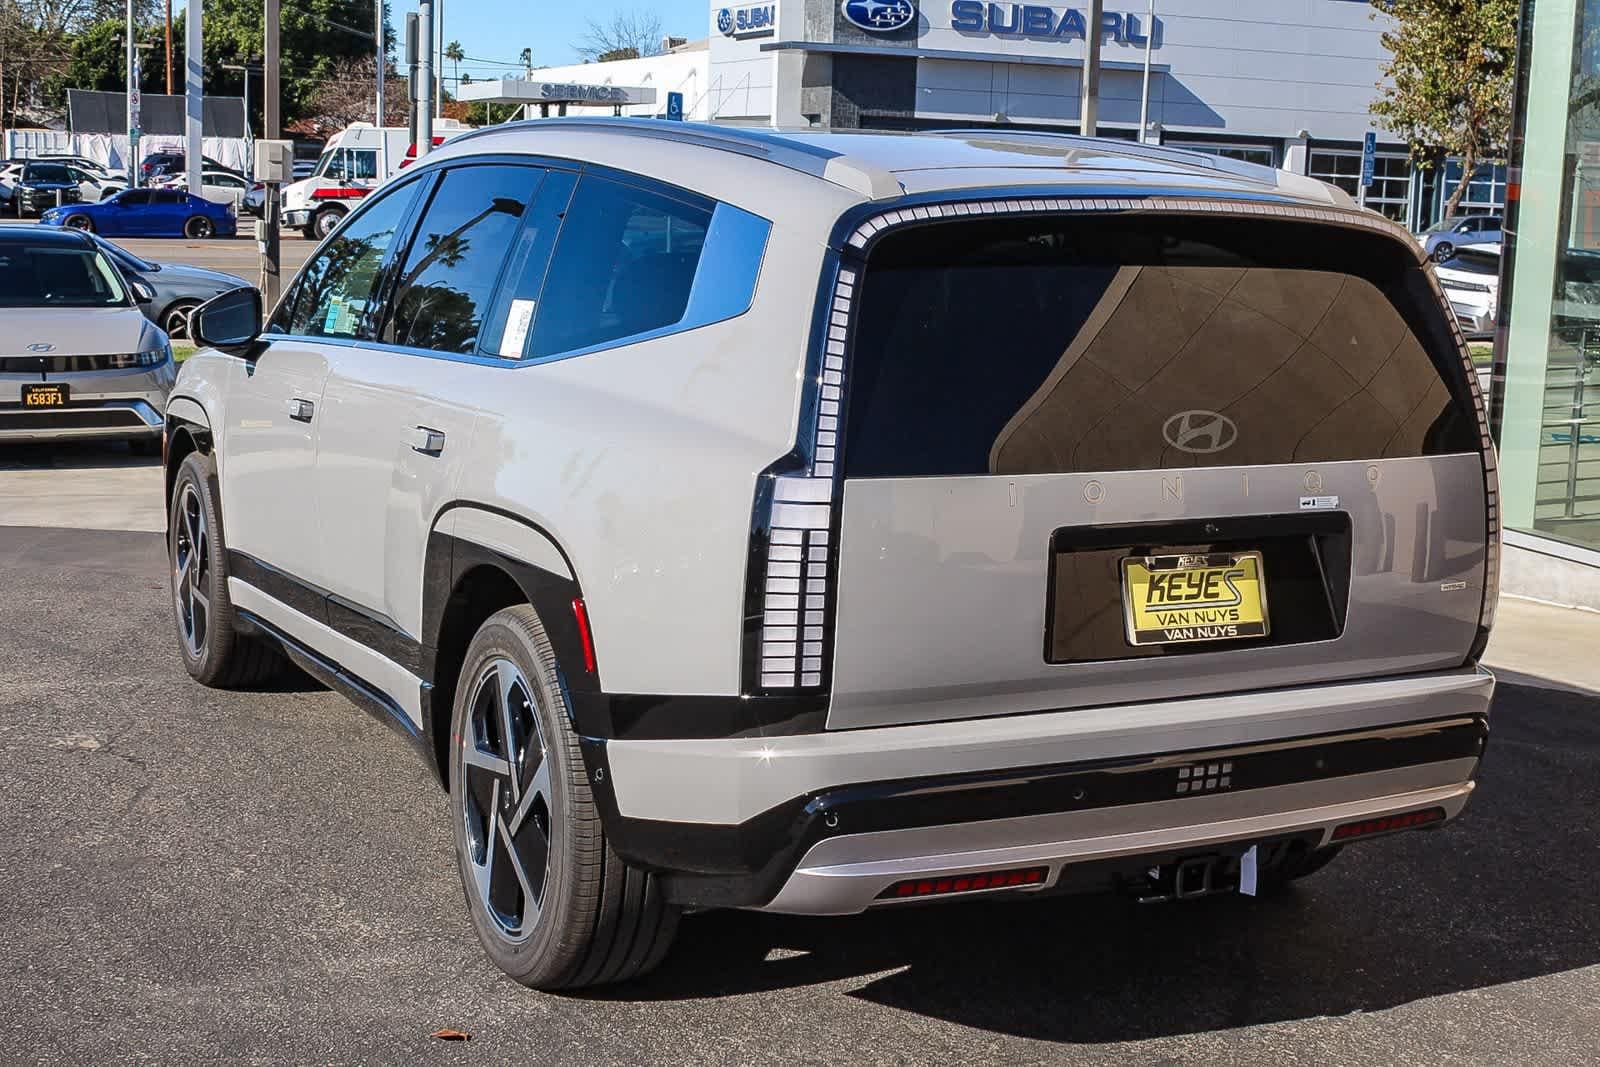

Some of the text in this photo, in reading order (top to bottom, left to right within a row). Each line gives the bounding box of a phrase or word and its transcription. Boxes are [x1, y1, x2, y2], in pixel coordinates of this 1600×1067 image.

[736, 5, 775, 30] SUBA
[541, 84, 628, 101] SERVICE
[26, 392, 64, 405] K583F1
[1177, 555, 1209, 567] KEYES
[1145, 569, 1245, 611] KEYES
[1156, 609, 1240, 626] VAN NUYS
[1165, 626, 1238, 640] VAN NUYS
